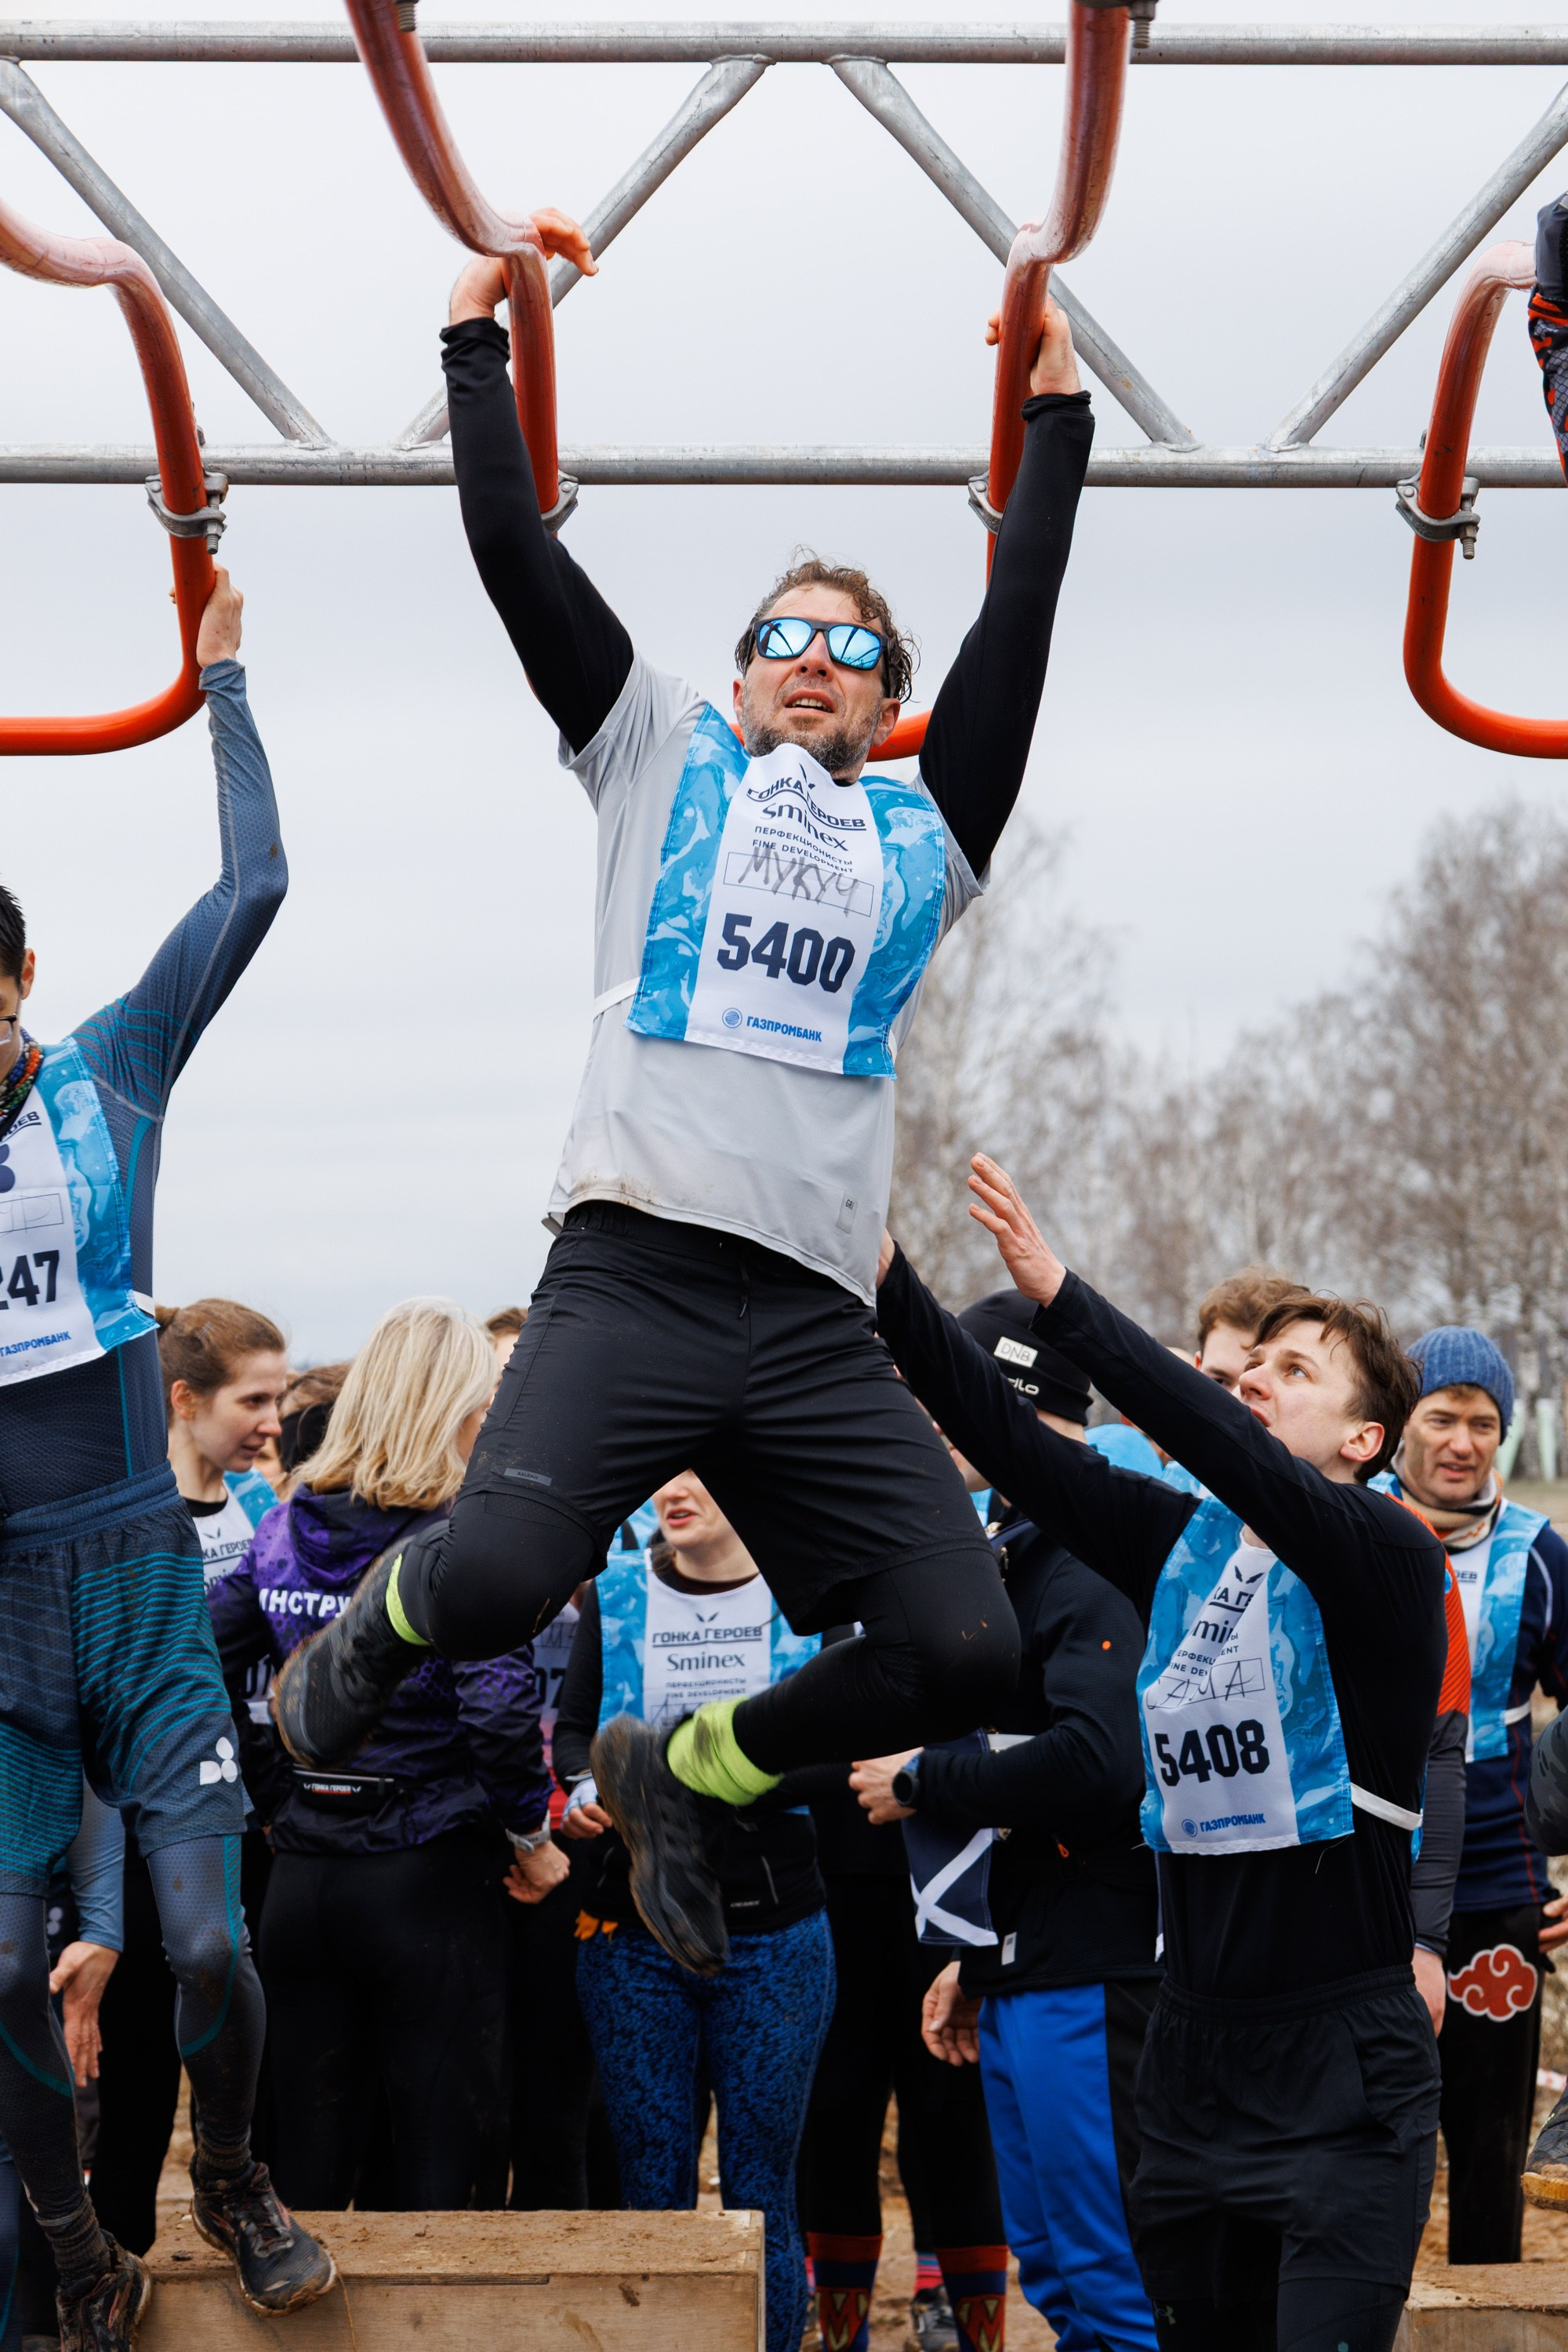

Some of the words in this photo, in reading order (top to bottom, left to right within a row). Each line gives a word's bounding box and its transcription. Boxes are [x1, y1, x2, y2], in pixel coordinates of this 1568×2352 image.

[747, 777, 804, 800] ГОНКА
[806, 790, 866, 828] ГЕРОЕВ
[752, 839, 777, 850] FINE
[782, 844, 854, 873] DEVELOPMENT
[754, 826, 853, 866] ПЕРФЕКЦИОНИСТЫ
[717, 913, 856, 994] 5400
[746, 1015, 823, 1043] ГАЗПРОМБАНК
[0, 1331, 71, 1357] ГАЗПРОМБАНК
[652, 1631, 701, 1643] ГОНКА
[705, 1626, 762, 1639] ГЕРОЕВ
[666, 1651, 746, 1671] Sminex
[688, 1688, 746, 1697] DEVELOPMENT
[1154, 1719, 1270, 1788] 5408
[1200, 1813, 1265, 1833] ГАЗПРОМБАНК
